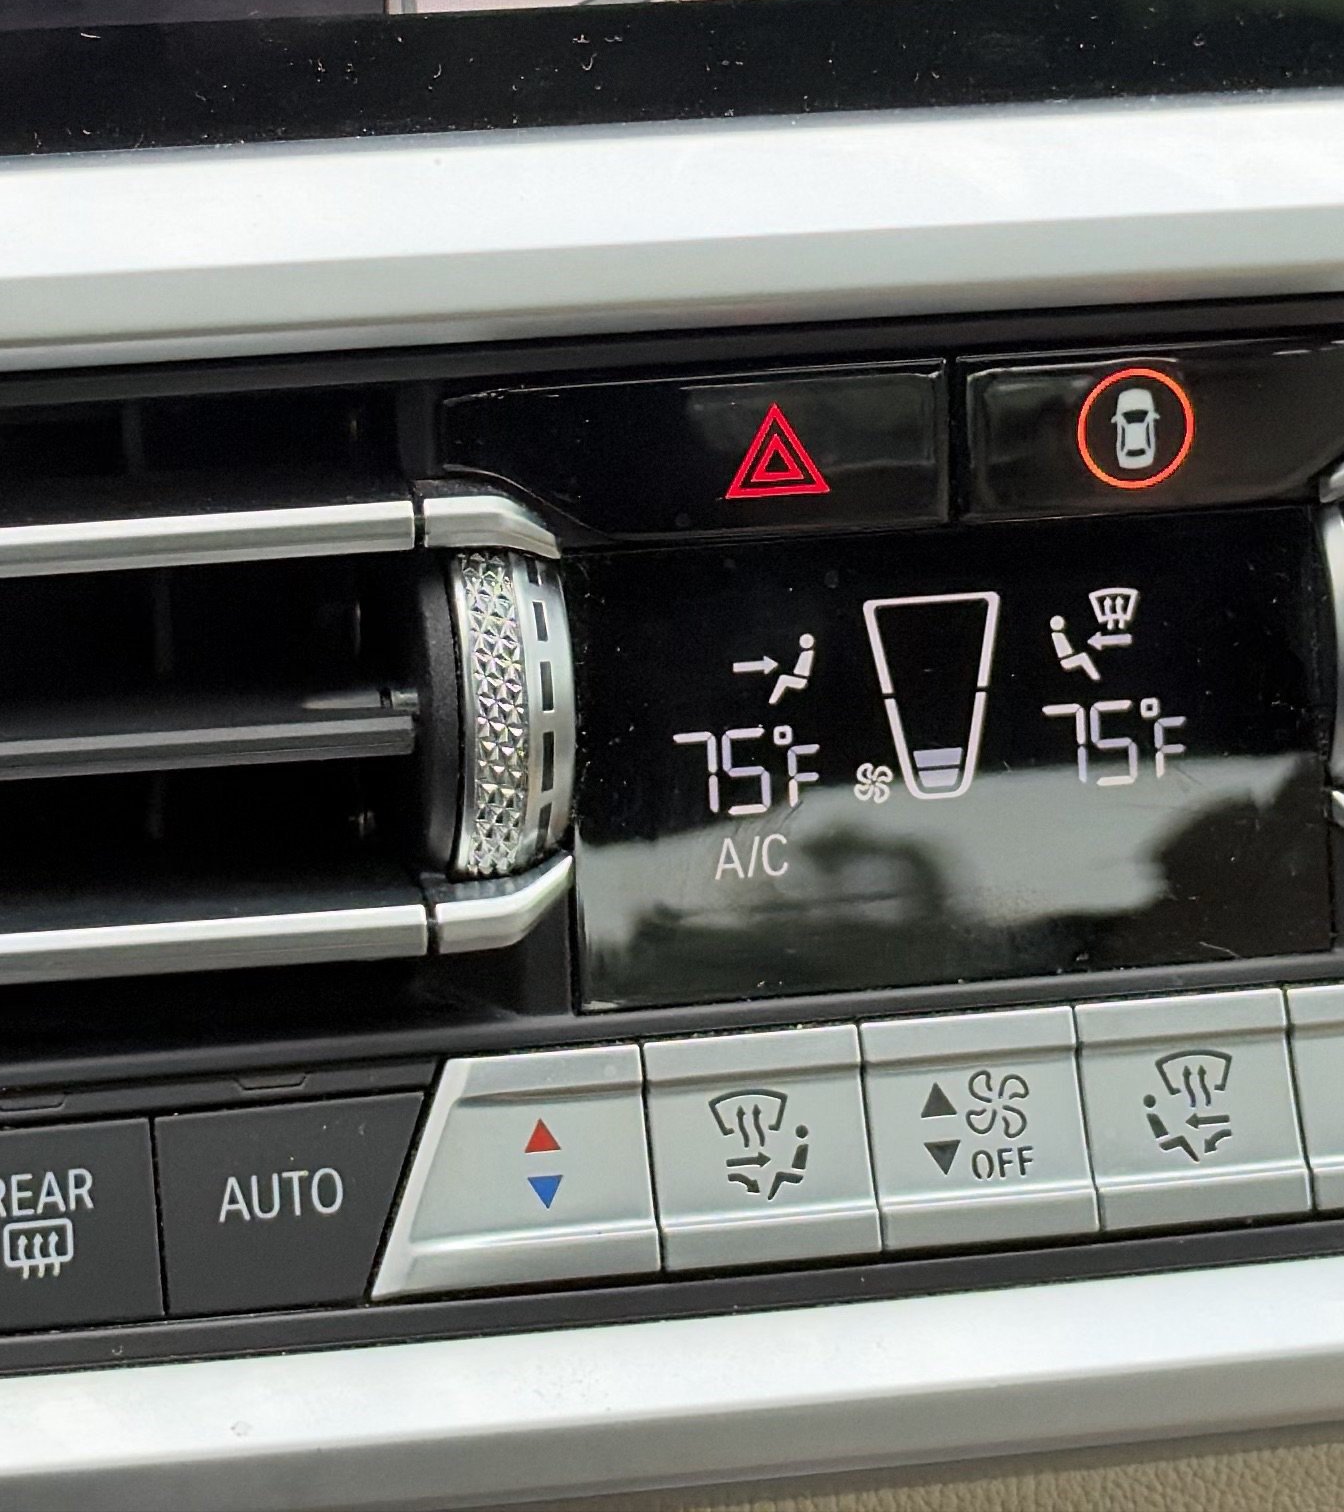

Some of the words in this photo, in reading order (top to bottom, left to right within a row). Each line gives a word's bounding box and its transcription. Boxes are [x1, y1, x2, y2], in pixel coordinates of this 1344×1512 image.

[716, 833, 788, 880] A/C
[971, 1146, 1033, 1180] OFF
[219, 1167, 343, 1222] AUTO
